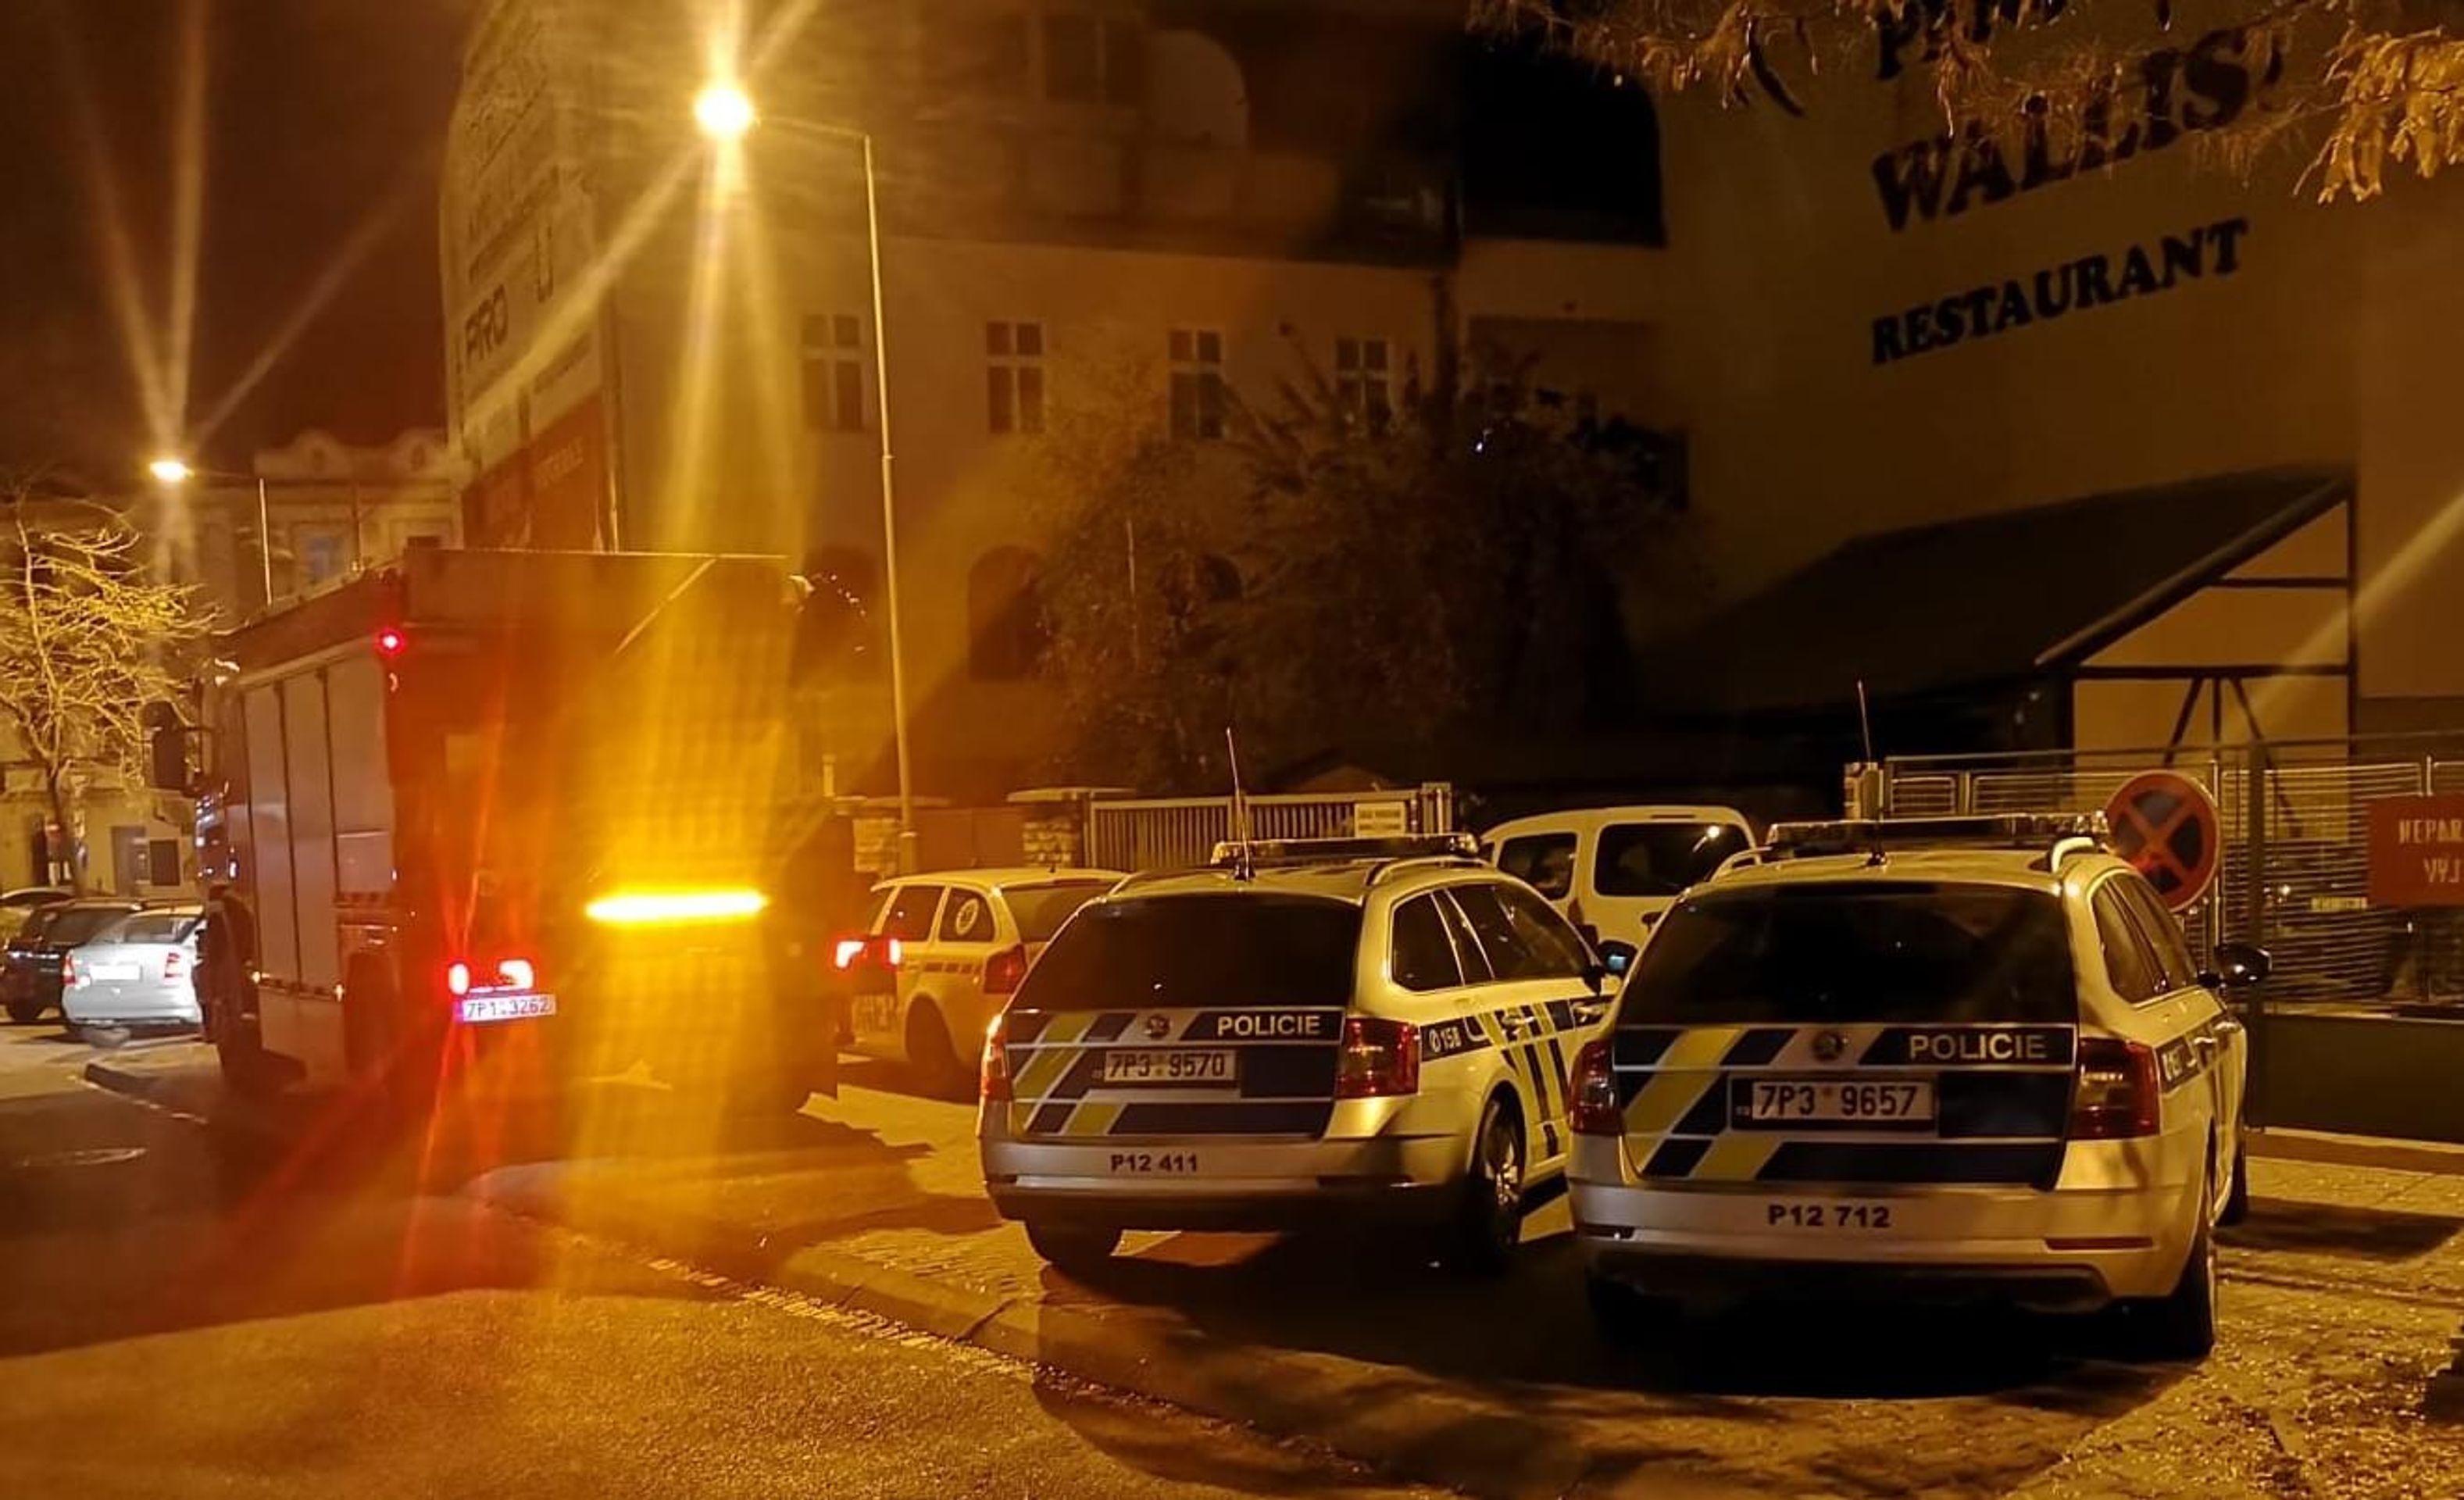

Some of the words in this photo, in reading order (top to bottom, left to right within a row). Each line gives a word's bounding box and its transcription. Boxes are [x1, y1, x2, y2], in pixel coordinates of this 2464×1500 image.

[1873, 216, 2248, 365] RESTAURANT
[1217, 1015, 1321, 1036] POLICIE
[1909, 1033, 2048, 1060] POLICIE
[1109, 1052, 1150, 1077] 7P3
[1169, 1052, 1225, 1077] 9570
[1759, 1084, 1816, 1116] 7P3
[1840, 1084, 1918, 1116] 9657
[1110, 1154, 1152, 1172] P12
[1159, 1154, 1198, 1172] 411
[1768, 1205, 1824, 1227] P12
[1834, 1205, 1891, 1228] 712
